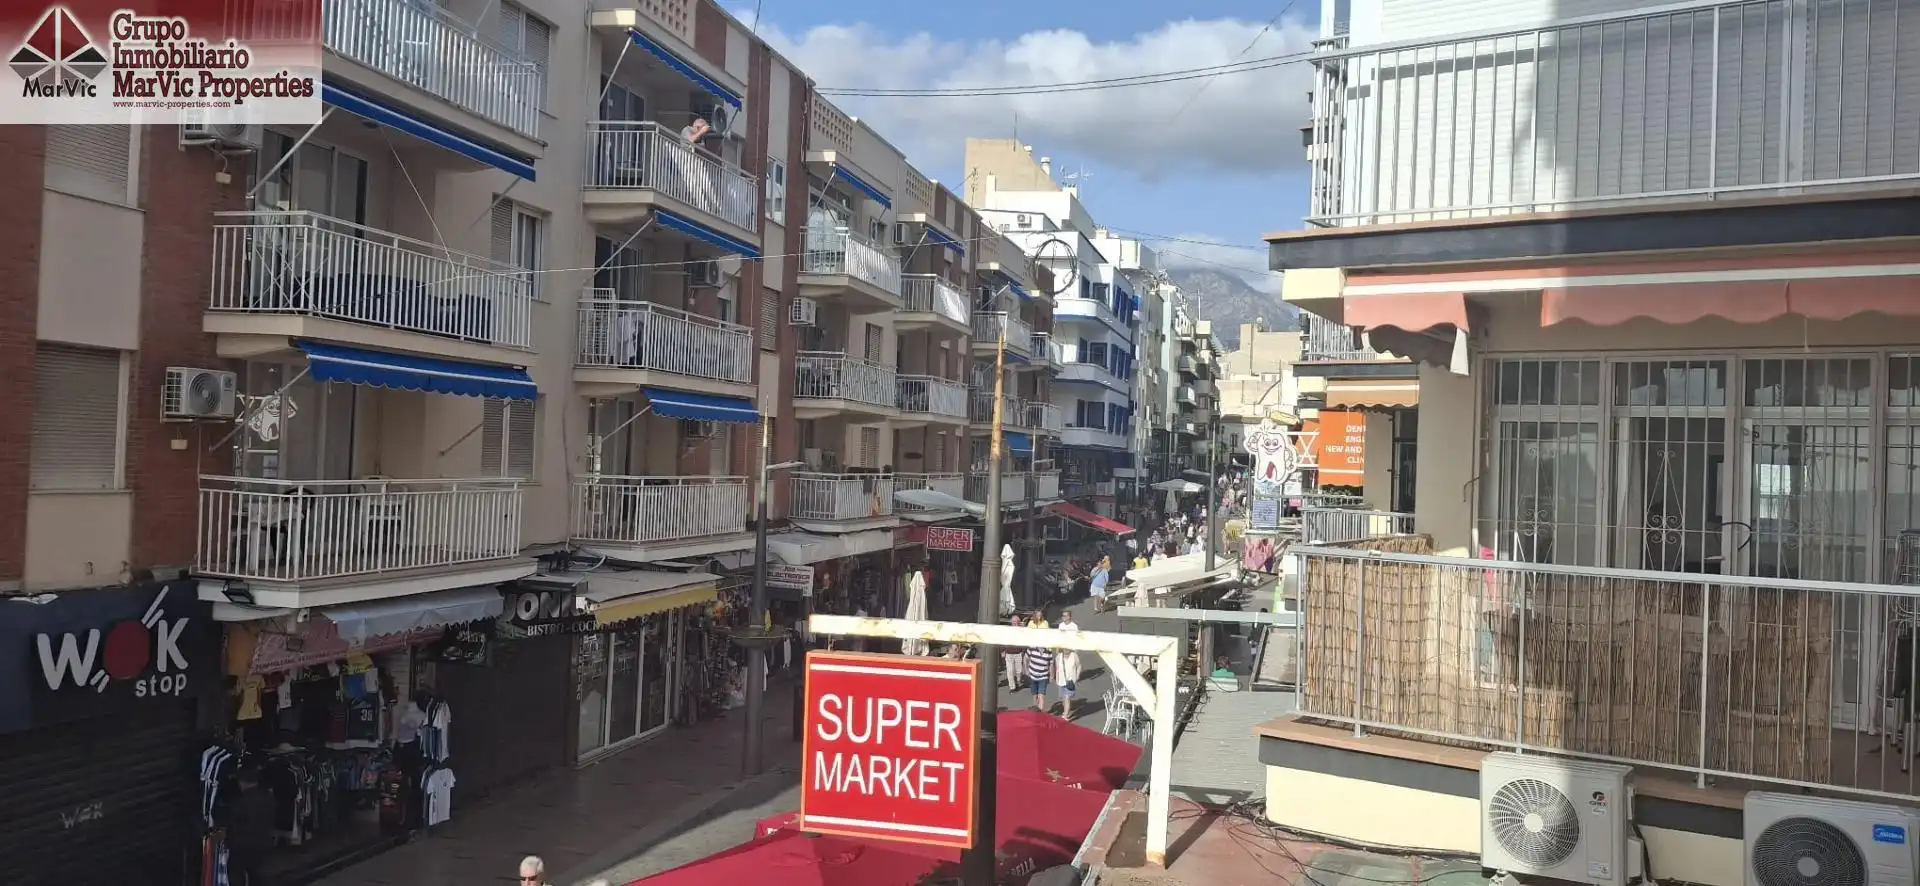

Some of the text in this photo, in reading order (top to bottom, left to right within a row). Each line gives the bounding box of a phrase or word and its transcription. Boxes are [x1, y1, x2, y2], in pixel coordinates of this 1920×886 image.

[1326, 445, 1362, 454] NEW AND
[930, 529, 969, 540] SUPER
[930, 538, 969, 549] MARKET
[136, 673, 187, 697] stop
[817, 693, 963, 751] SUPER
[814, 751, 965, 803] MARKET
